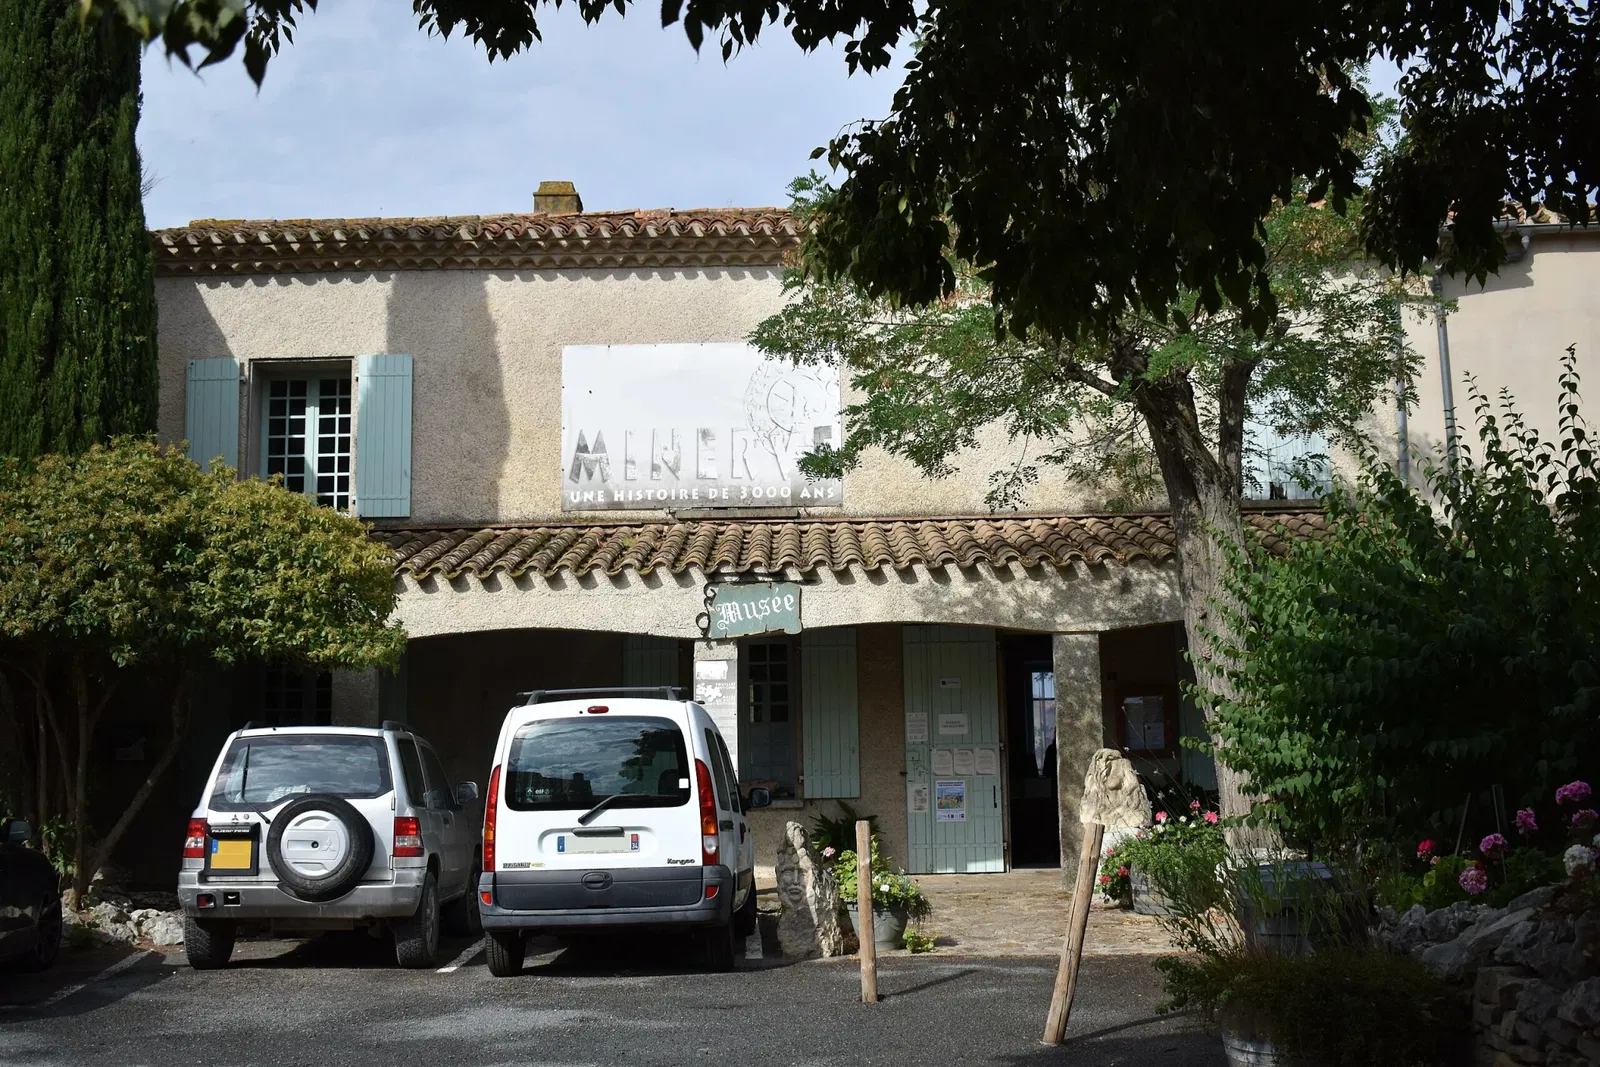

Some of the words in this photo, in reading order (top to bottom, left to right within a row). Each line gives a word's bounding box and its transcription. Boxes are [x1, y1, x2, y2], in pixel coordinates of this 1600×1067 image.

[570, 490, 604, 503] UNE
[613, 487, 699, 502] HISTOIRE
[708, 488, 729, 500] DE
[739, 485, 792, 499] 3000
[799, 487, 835, 499] ANS
[715, 587, 795, 630] Musée
